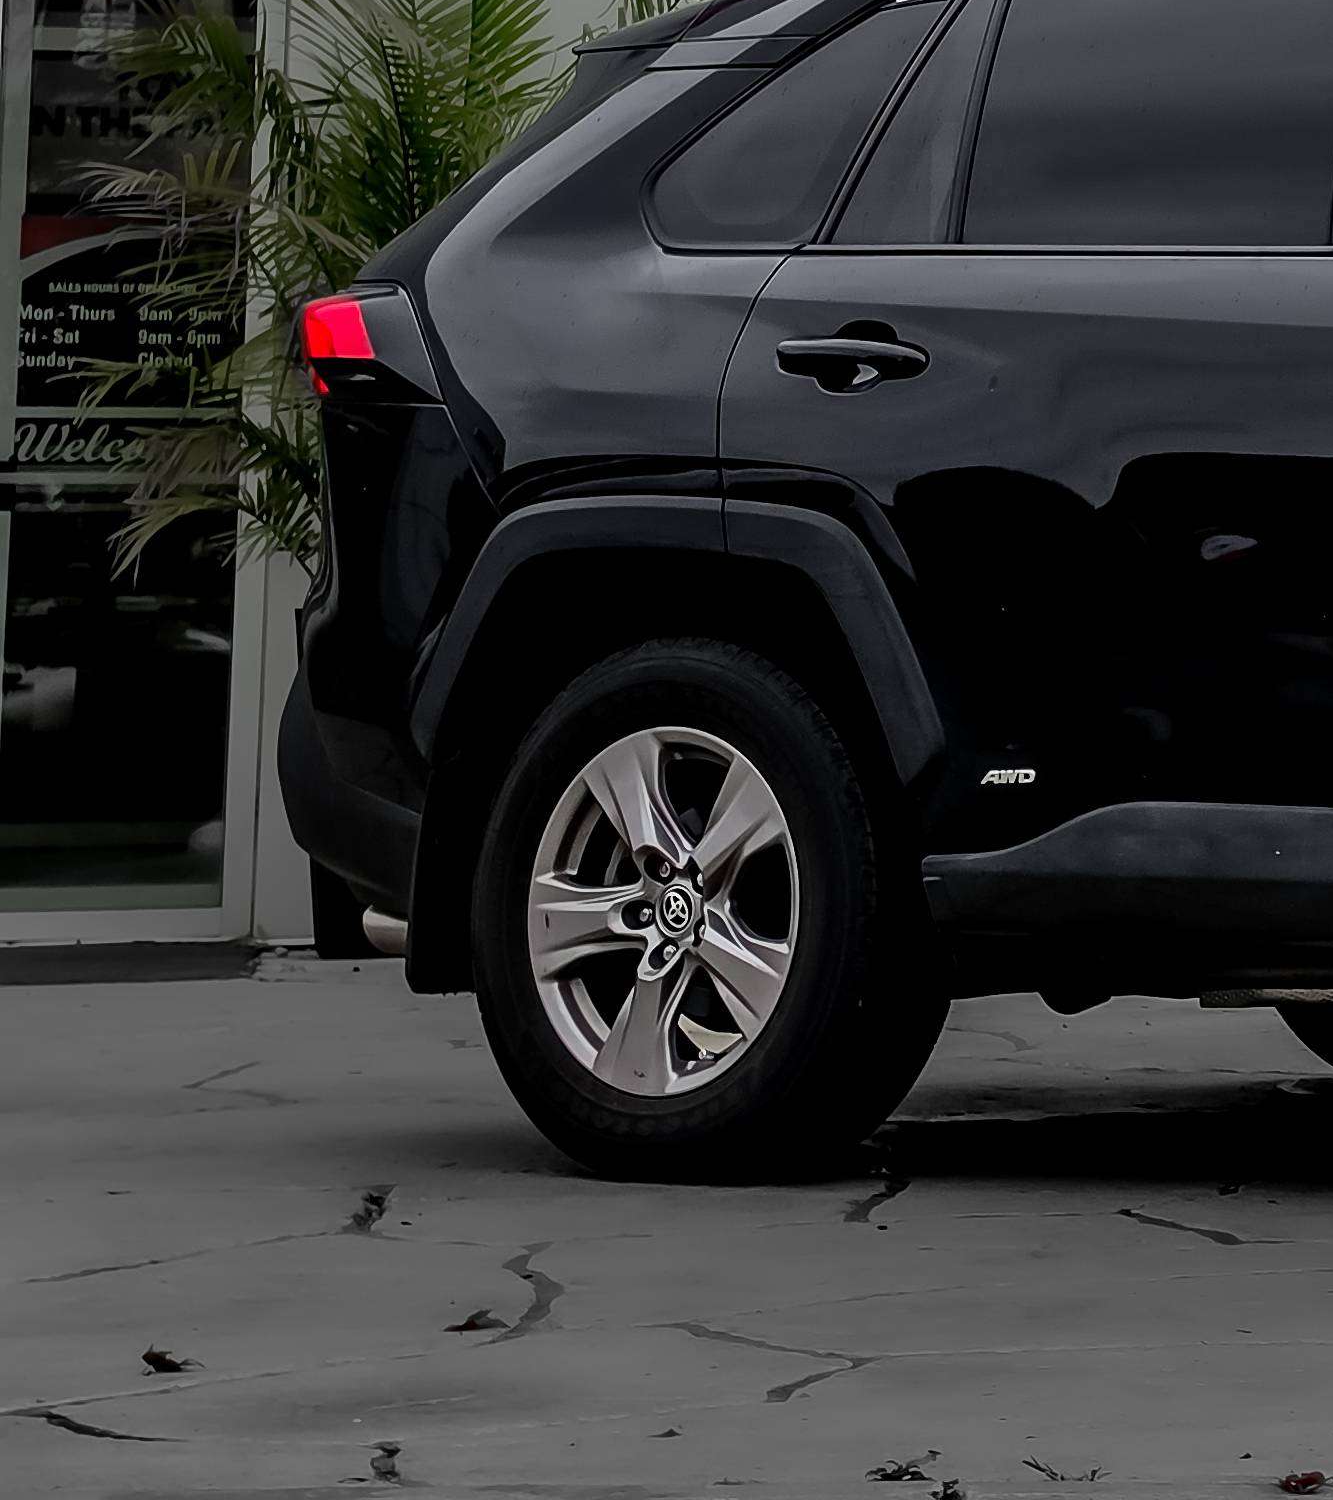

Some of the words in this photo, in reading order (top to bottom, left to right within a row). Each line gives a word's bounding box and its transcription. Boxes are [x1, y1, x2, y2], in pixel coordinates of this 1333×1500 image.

[18, 304, 54, 321] Mon
[69, 304, 116, 321] Thurs
[53, 327, 80, 345] Sat
[138, 328, 172, 345] 9am
[980, 769, 1036, 785] AWD
